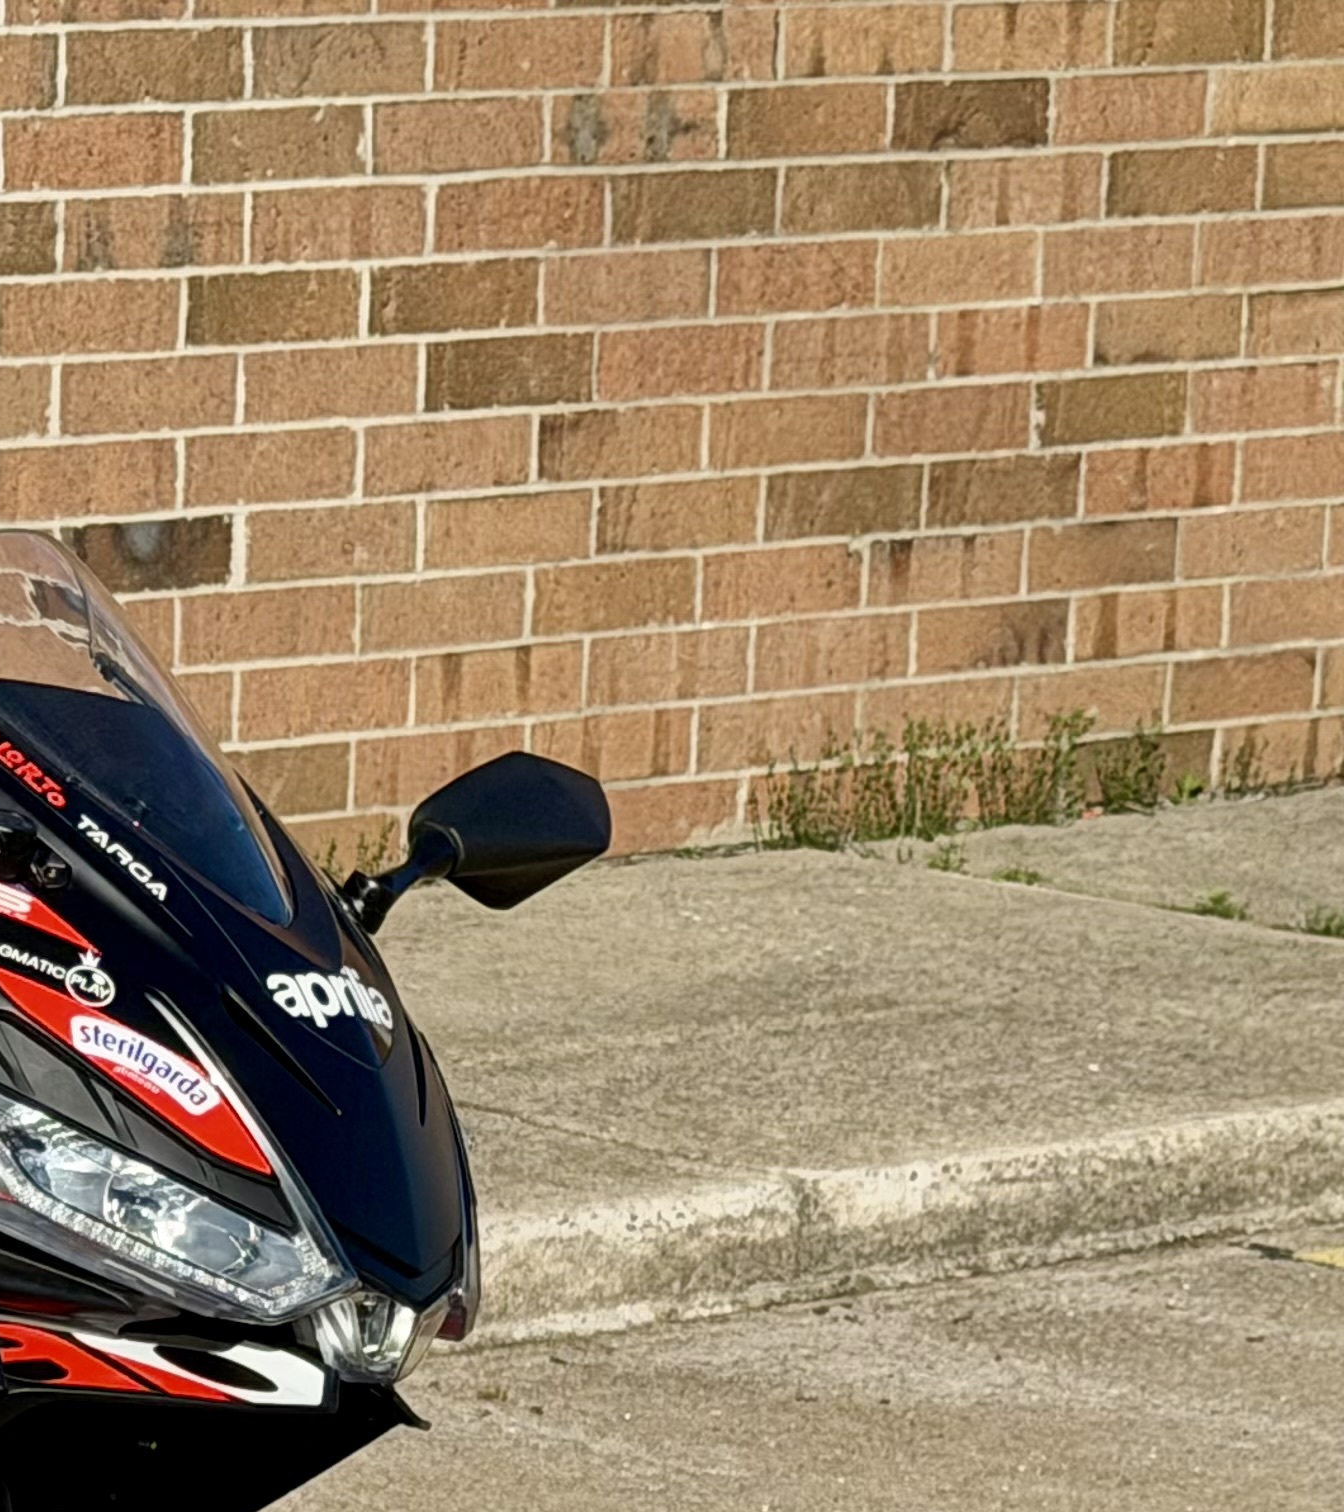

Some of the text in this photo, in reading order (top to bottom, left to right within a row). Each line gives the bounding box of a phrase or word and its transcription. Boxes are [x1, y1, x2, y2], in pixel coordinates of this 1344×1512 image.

[77, 814, 169, 901] TARGA
[70, 973, 111, 1000] PLAY
[266, 965, 393, 1030] aprilia
[79, 1025, 208, 1106] sterilgarda
